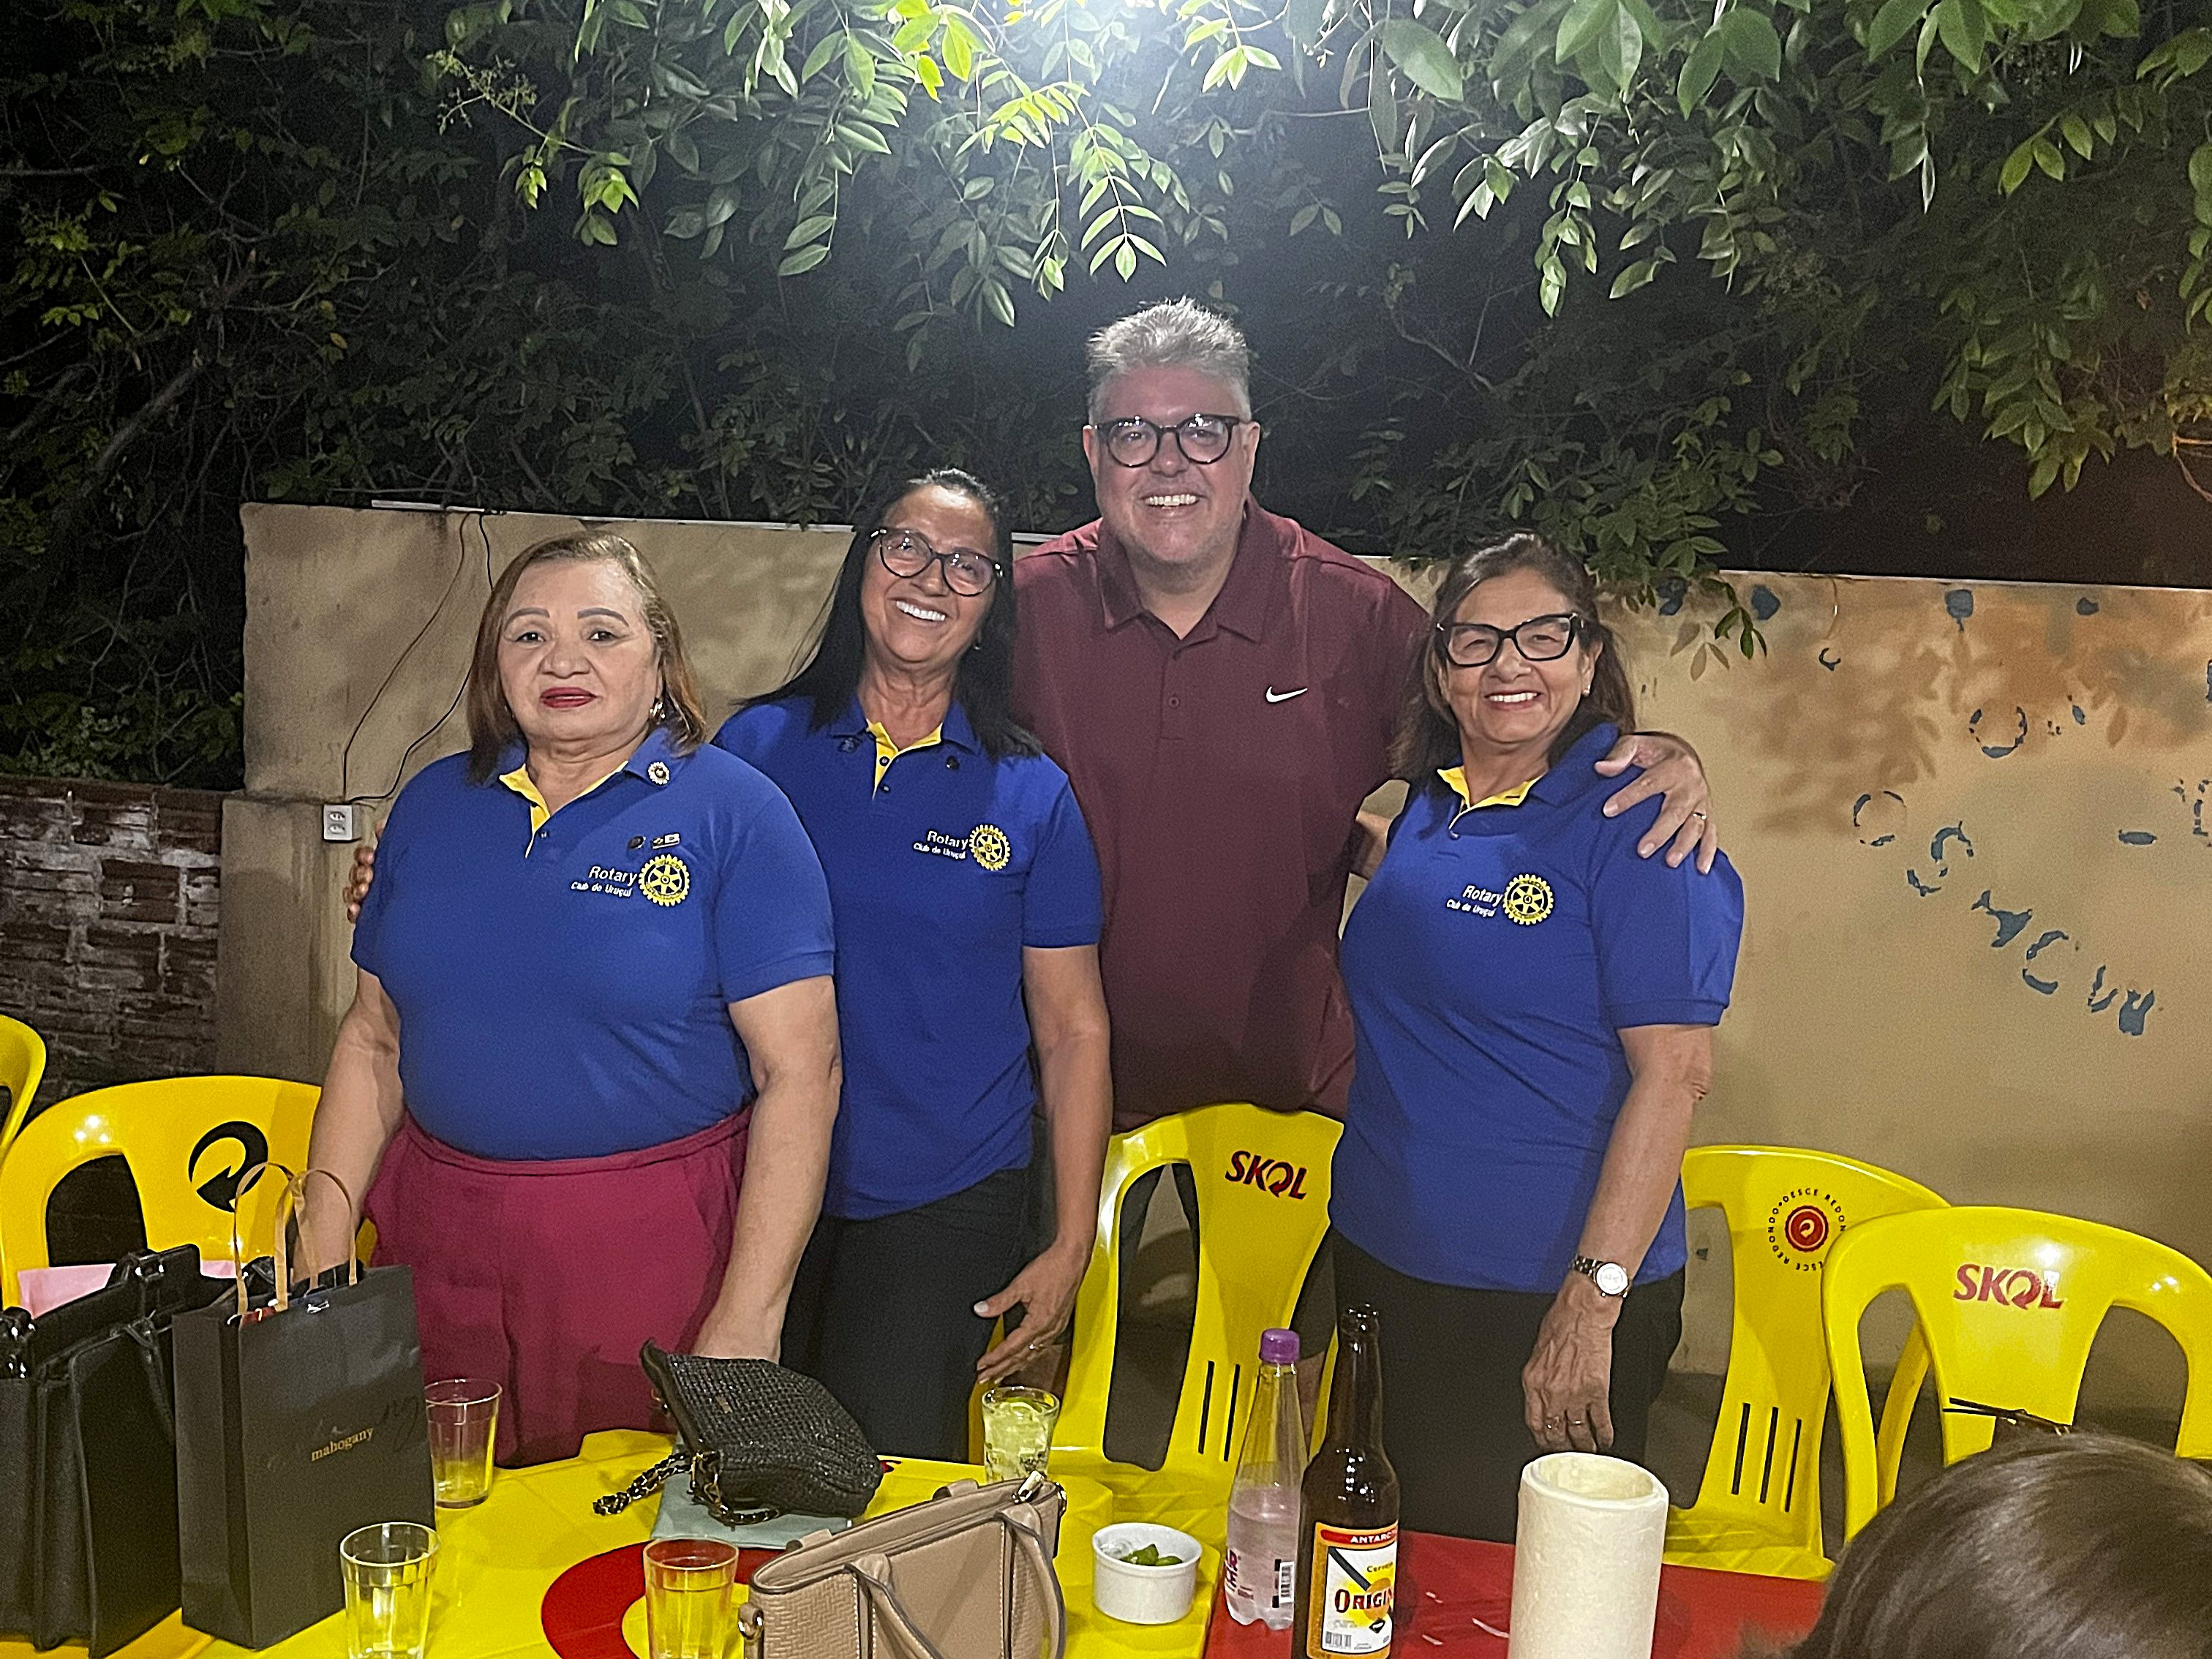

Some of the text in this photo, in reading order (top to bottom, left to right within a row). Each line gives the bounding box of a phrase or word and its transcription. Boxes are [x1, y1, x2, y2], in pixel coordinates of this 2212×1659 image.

[927, 830, 968, 850] Rotary
[588, 865, 638, 887] Rotary
[1462, 884, 1503, 907] Rotary
[1224, 1150, 1308, 1200] SKOL
[1782, 1187, 1818, 1203] DESCE
[1824, 1194, 1846, 1232] REDON
[1795, 1260, 1824, 1272] ESCE
[1952, 1263, 2066, 1311] SKOL
[311, 1427, 375, 1462] mahogany
[1334, 1587, 1393, 1614] ORIGIN
